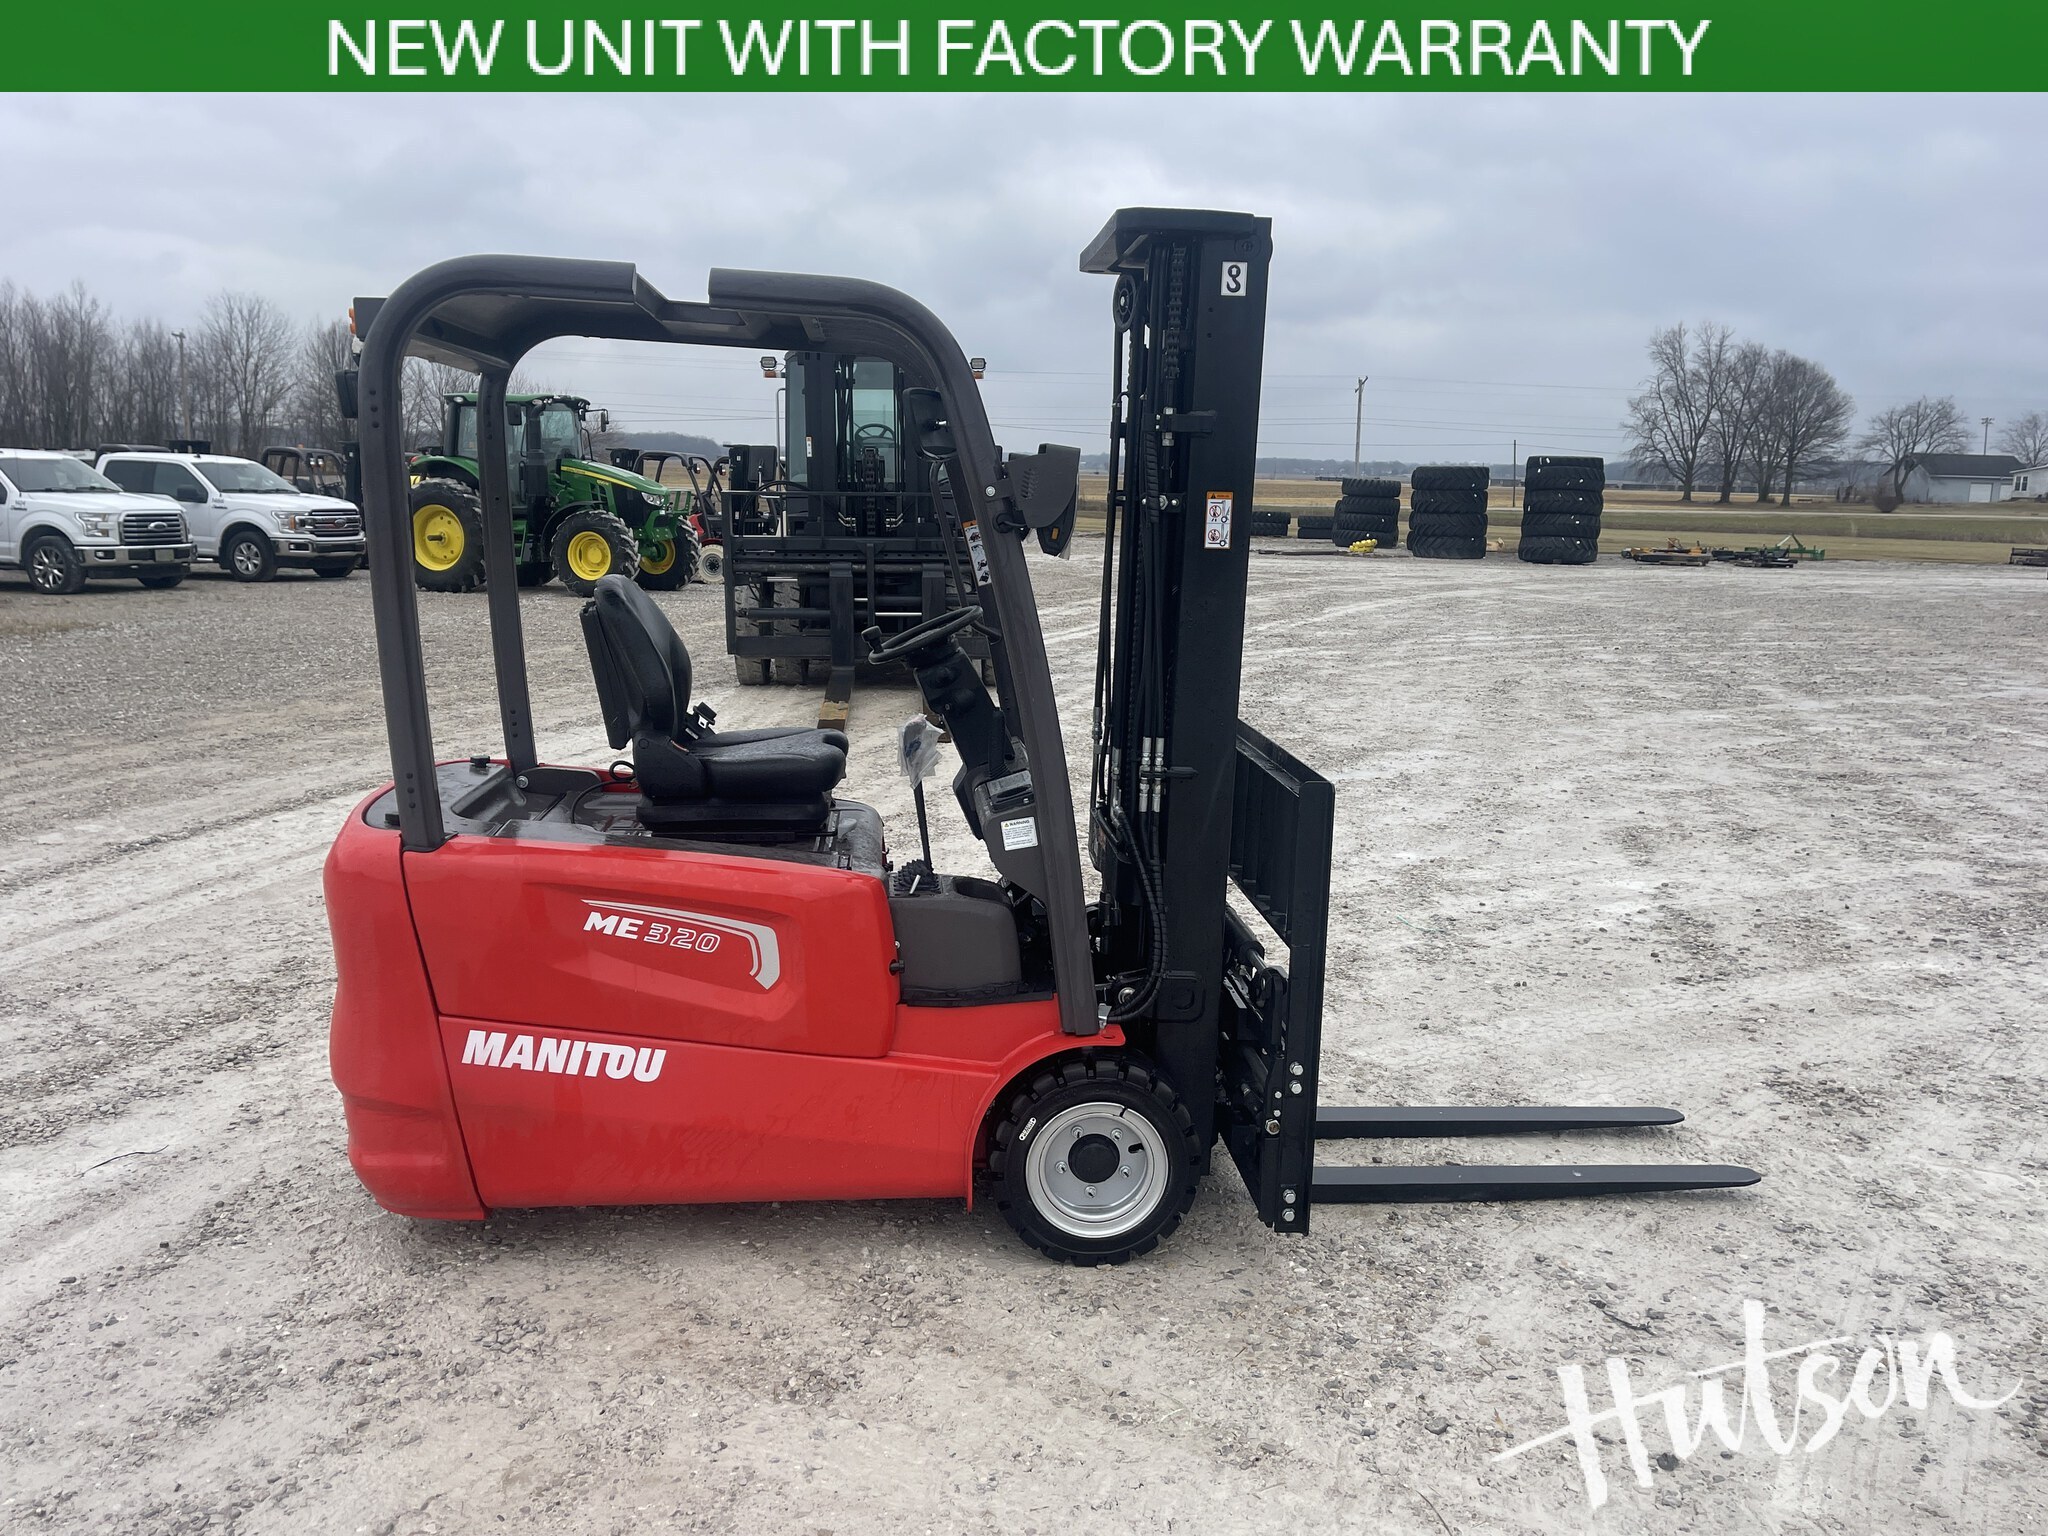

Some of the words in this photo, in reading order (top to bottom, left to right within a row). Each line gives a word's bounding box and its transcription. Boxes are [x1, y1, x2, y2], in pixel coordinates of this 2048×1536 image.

[1009, 819, 1030, 827] WARNING
[583, 911, 645, 941] ME
[643, 922, 721, 953] 320
[461, 1029, 667, 1083] MANITOU
